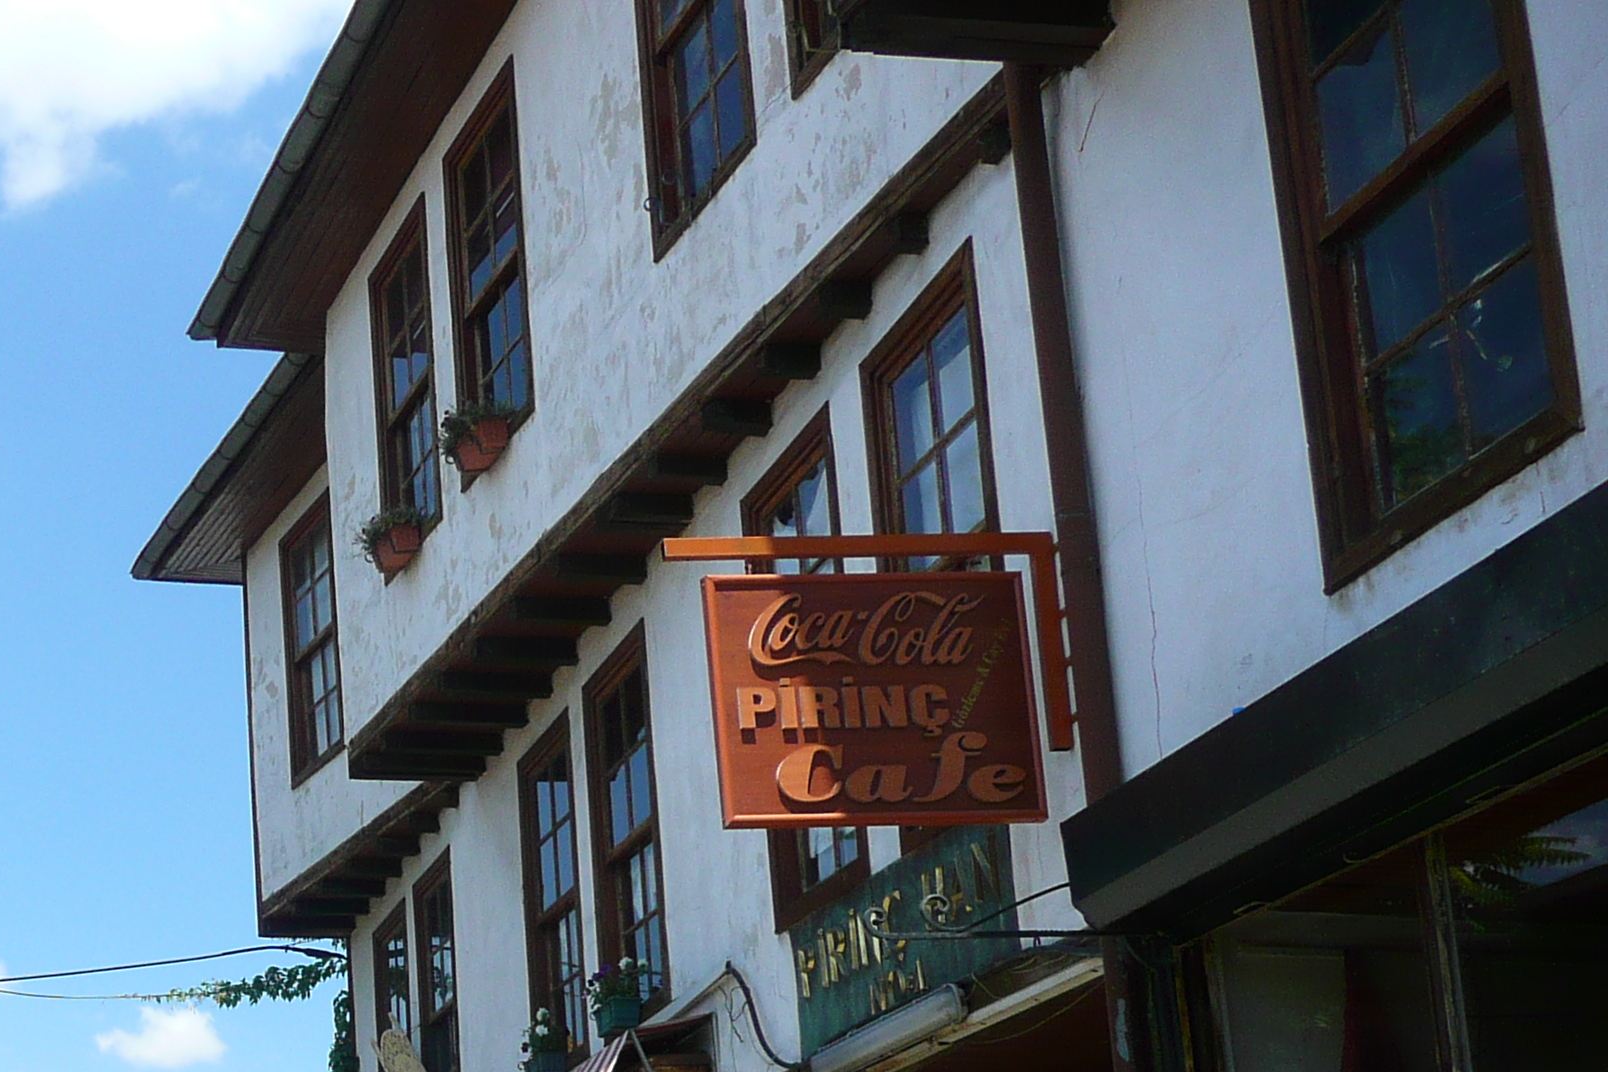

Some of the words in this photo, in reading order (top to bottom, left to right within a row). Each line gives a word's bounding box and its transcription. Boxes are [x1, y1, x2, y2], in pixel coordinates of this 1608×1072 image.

[748, 591, 985, 667] Coca-Cola
[737, 676, 950, 738] PİRİNÇ
[776, 730, 1027, 804] Cafe
